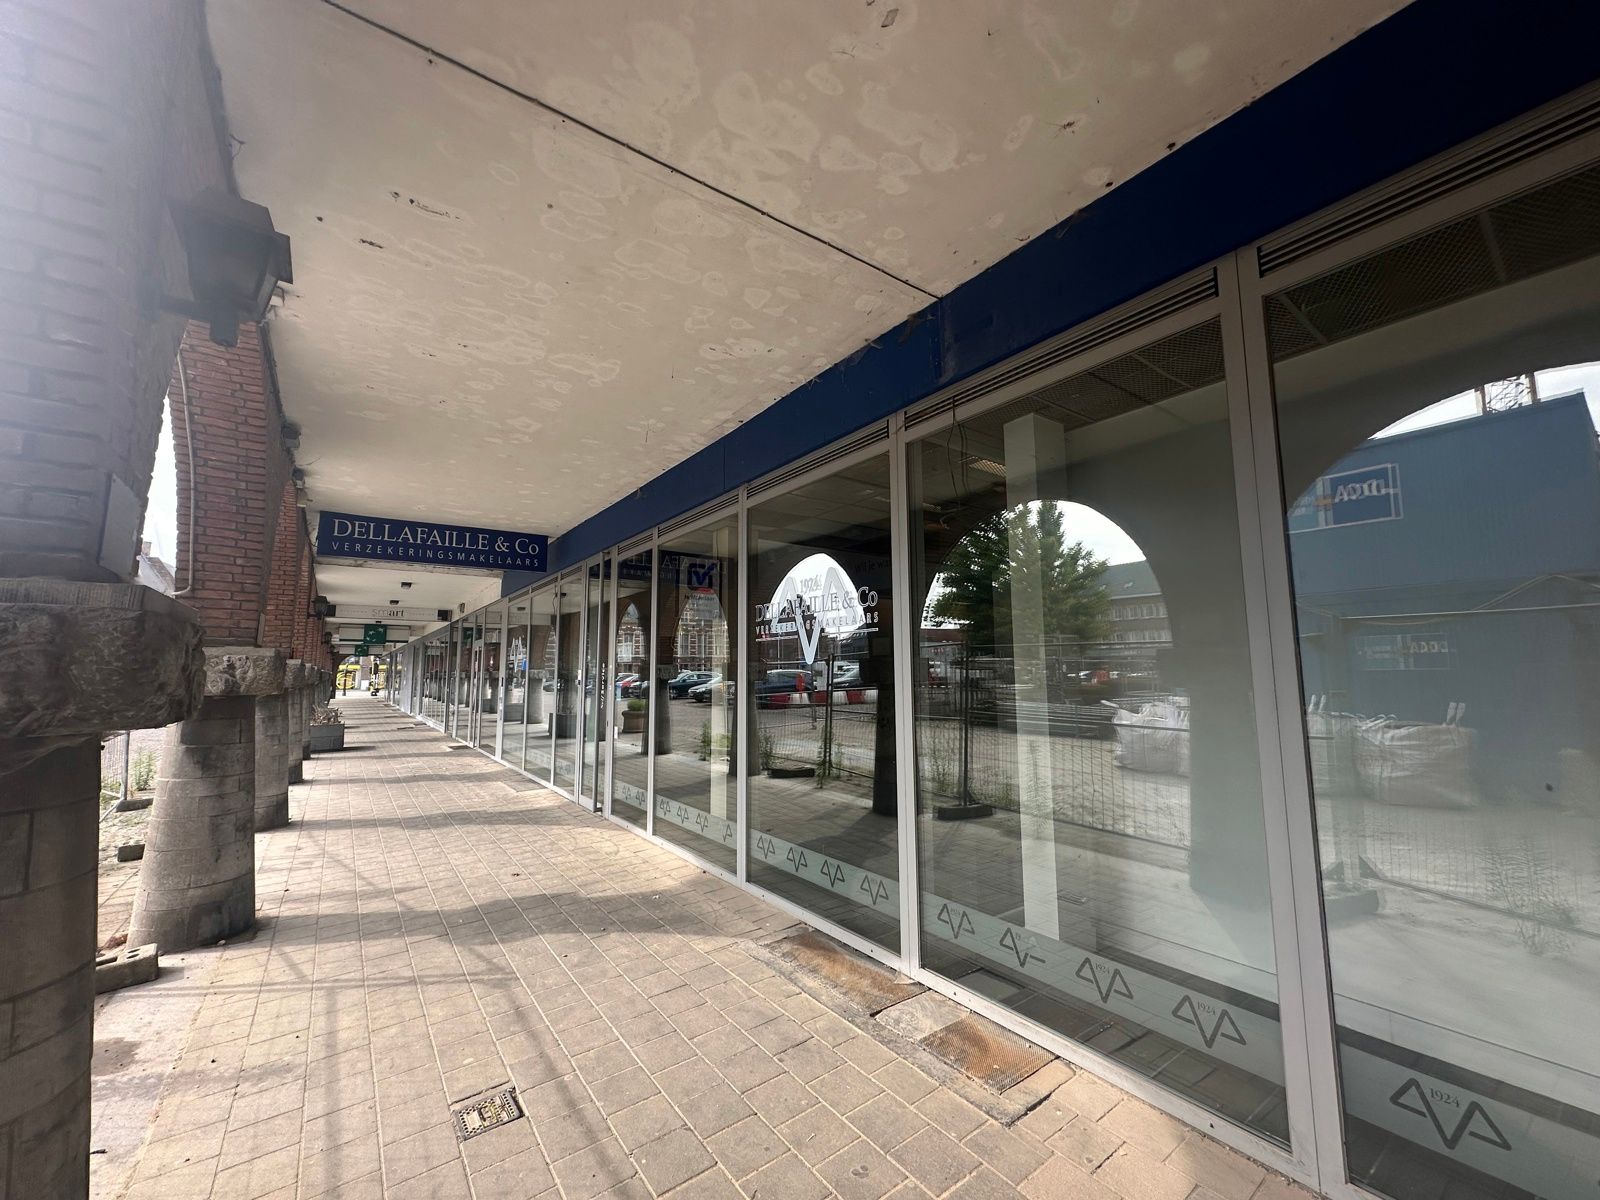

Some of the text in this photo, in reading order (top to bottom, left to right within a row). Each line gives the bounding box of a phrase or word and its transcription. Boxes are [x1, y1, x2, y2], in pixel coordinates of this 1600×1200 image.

[333, 519, 539, 555] DELLAFAILLE & Co
[331, 541, 539, 567] VERZEKERINGSMAKELAARS
[857, 586, 879, 607] Co
[1429, 1087, 1460, 1108] 1924
